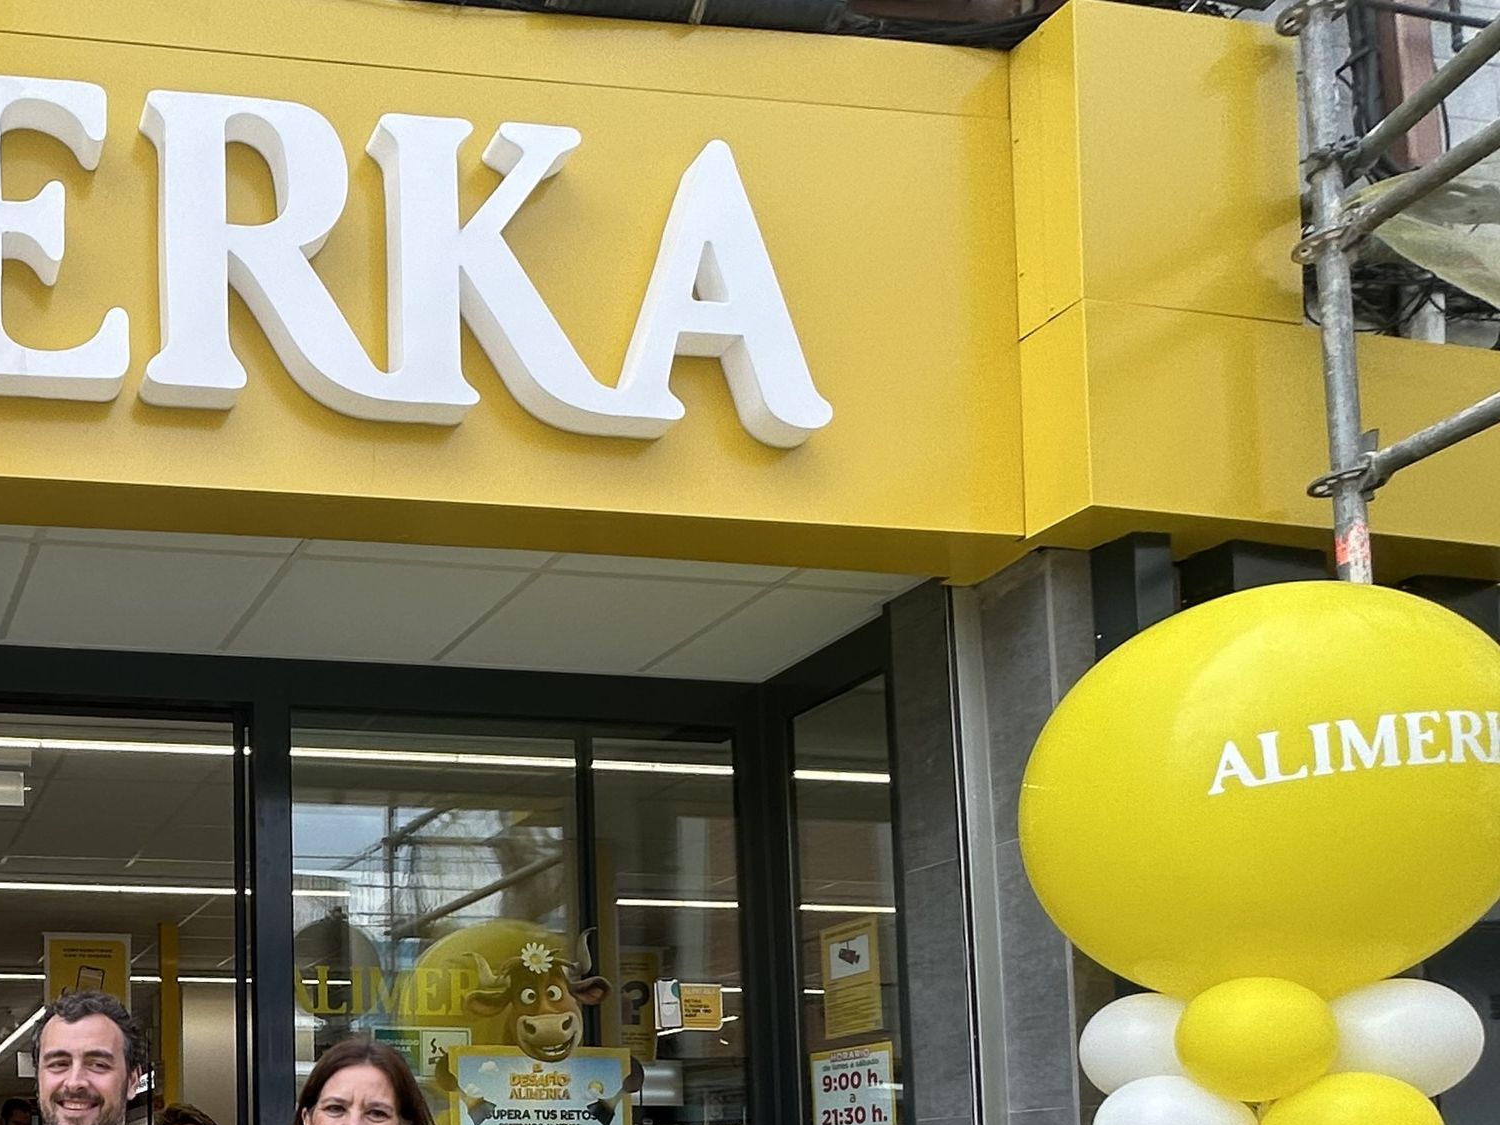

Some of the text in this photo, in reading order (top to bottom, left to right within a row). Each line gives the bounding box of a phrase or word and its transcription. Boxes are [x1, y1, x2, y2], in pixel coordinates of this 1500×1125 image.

[1207, 709, 1500, 796] ALIMER
[830, 1048, 869, 1063] HORARIO
[822, 1069, 884, 1092] 9:00 h.
[509, 1088, 571, 1100] ALIMERKA
[849, 1093, 856, 1103] a
[534, 1110, 557, 1120] TUS
[872, 1104, 888, 1122] h.
